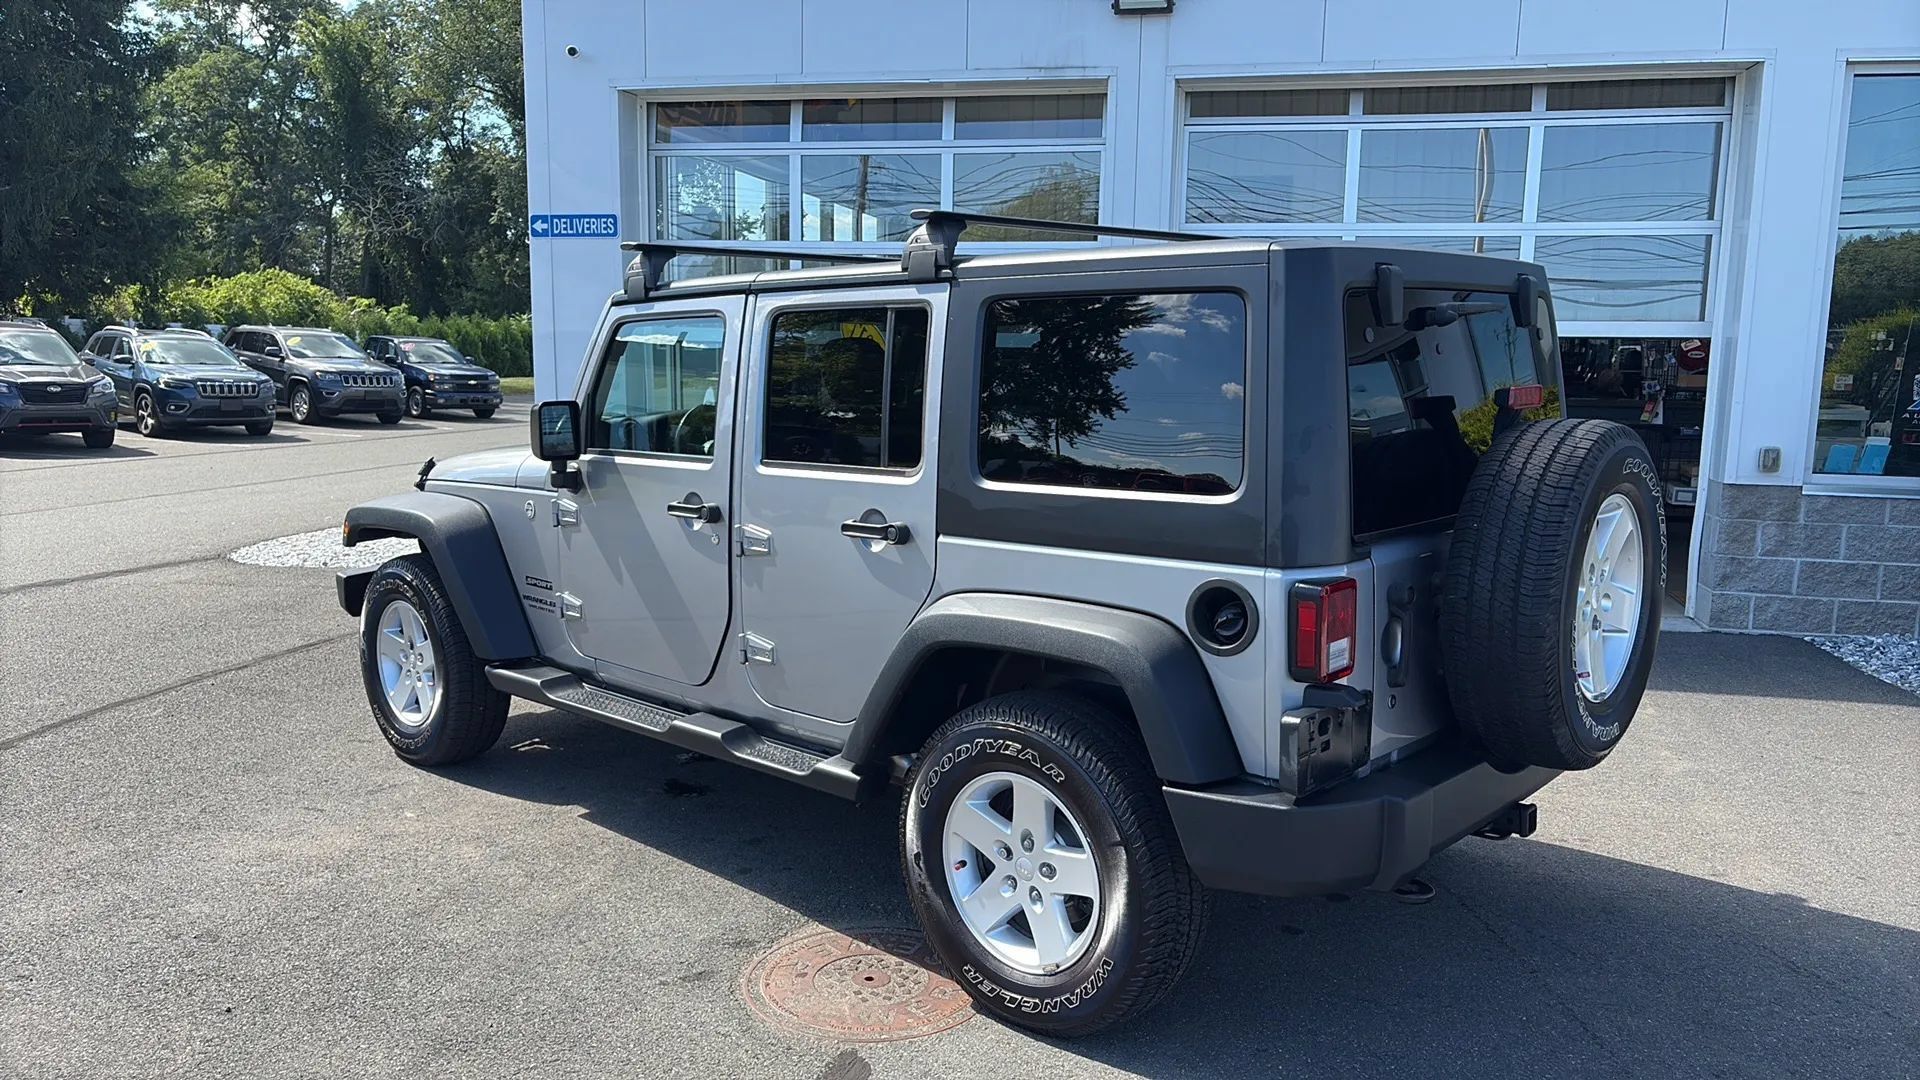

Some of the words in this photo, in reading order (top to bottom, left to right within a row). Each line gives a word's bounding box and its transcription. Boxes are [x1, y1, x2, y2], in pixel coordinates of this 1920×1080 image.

[553, 218, 614, 233] DELIVERIES
[1622, 457, 1668, 588] GOODYEAR
[526, 577, 553, 591] SPORT
[918, 738, 1066, 808] GOODYEAR
[961, 956, 1114, 1014] WRANGLER
